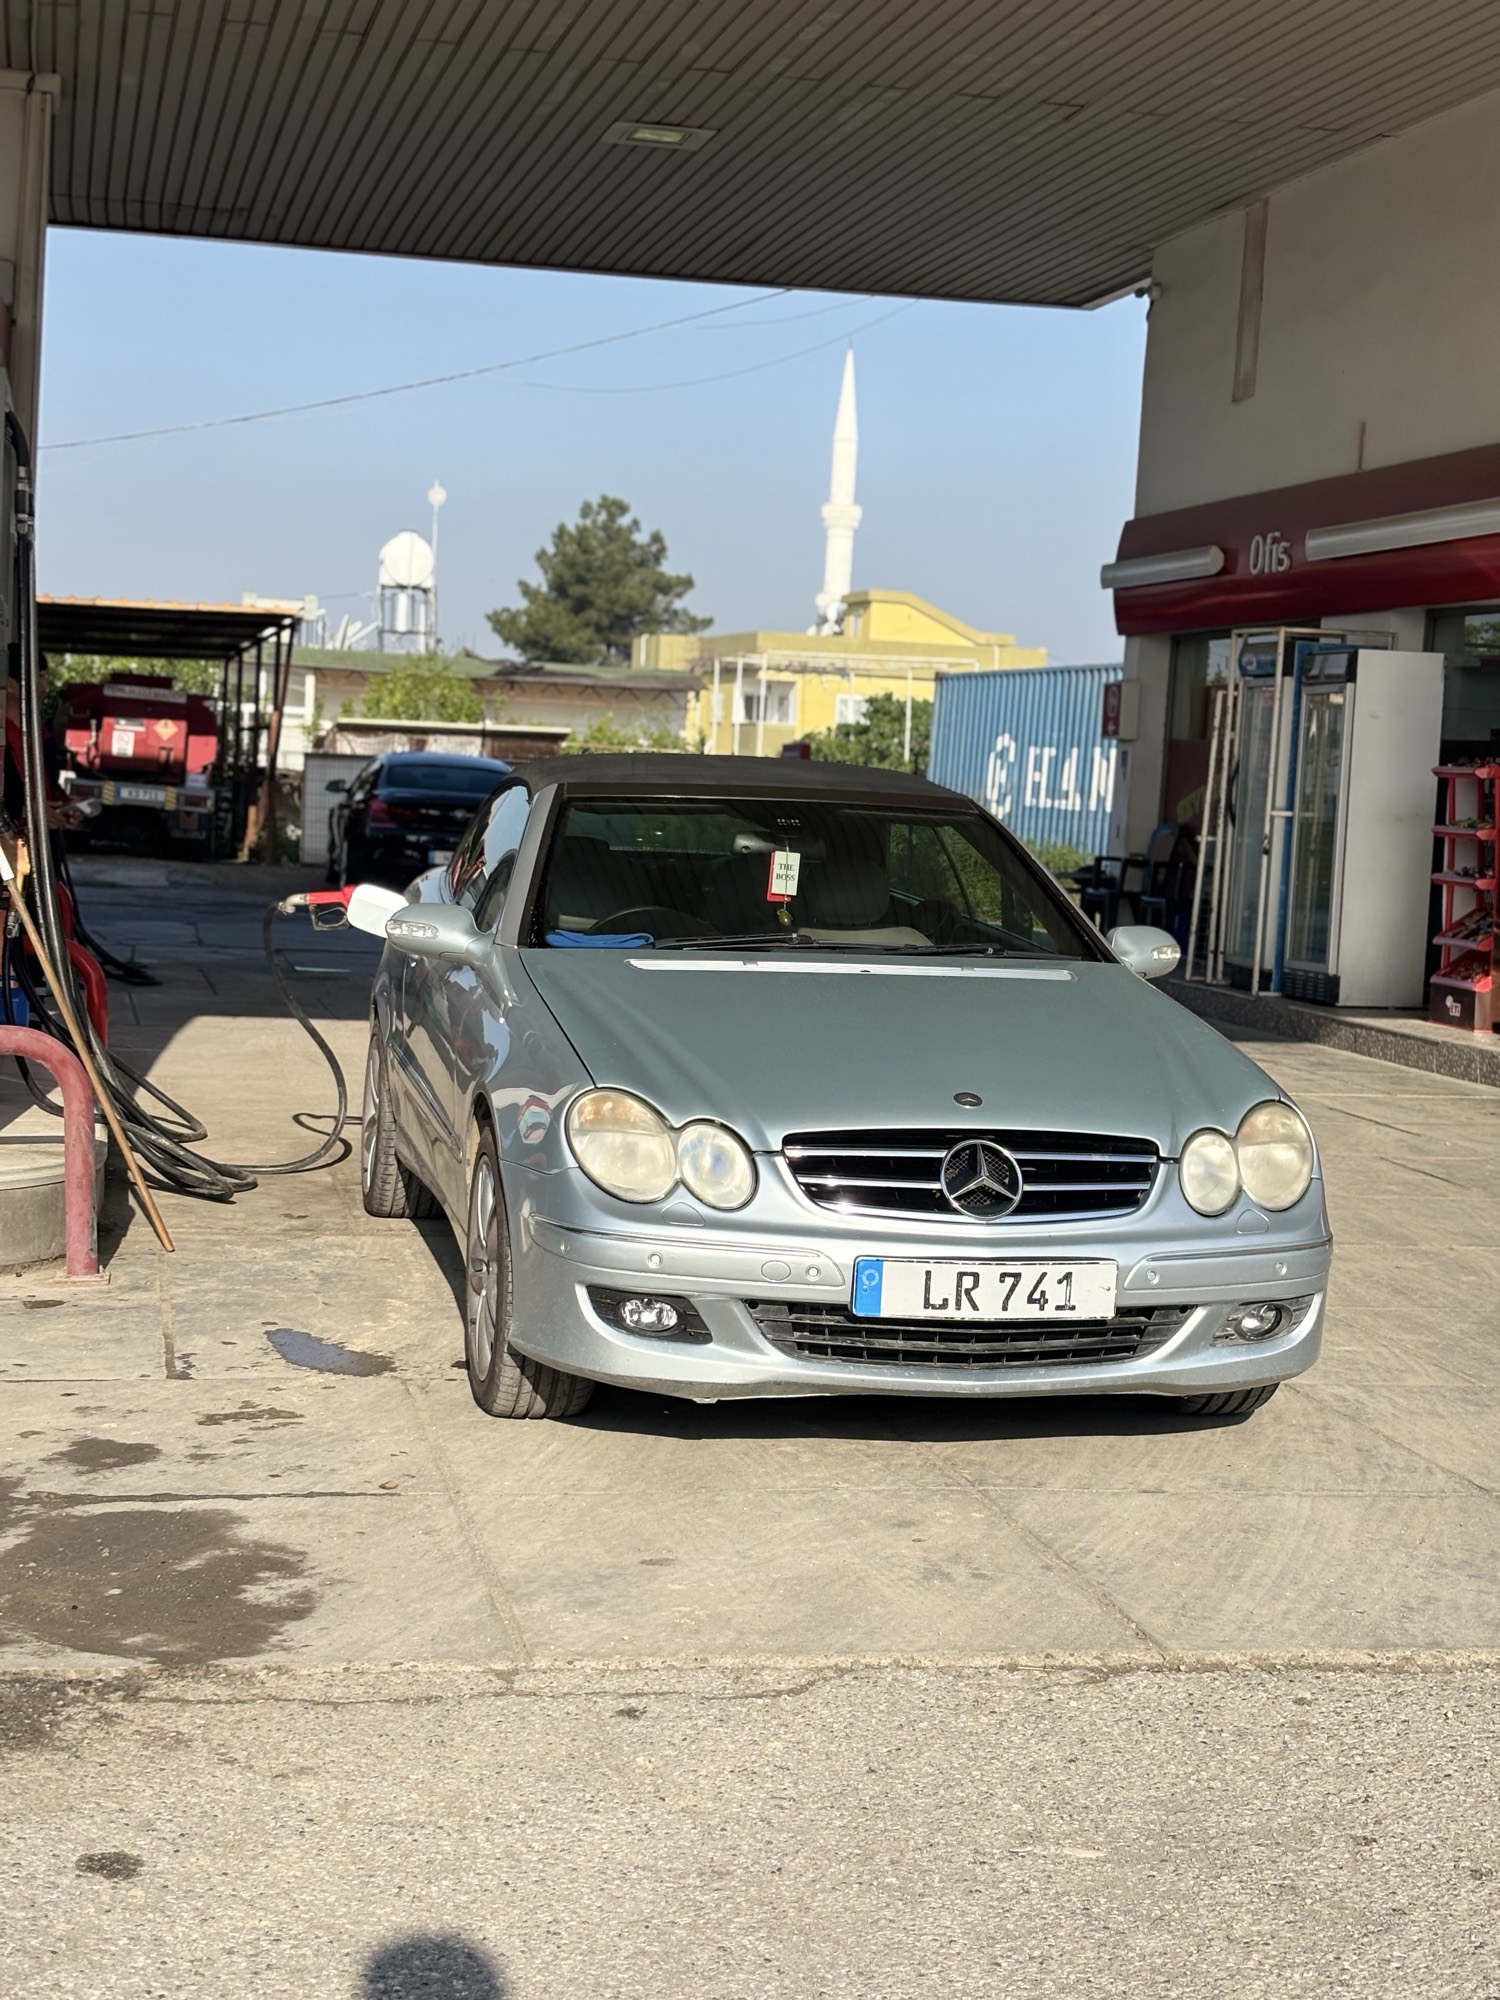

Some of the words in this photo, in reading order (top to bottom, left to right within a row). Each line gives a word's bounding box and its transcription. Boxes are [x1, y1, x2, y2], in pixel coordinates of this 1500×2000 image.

[1250, 531, 1291, 575] Ofis
[776, 873, 796, 882] BOSS
[778, 863, 795, 871] THE
[923, 1269, 980, 1312] LR
[999, 1271, 1077, 1312] 741
